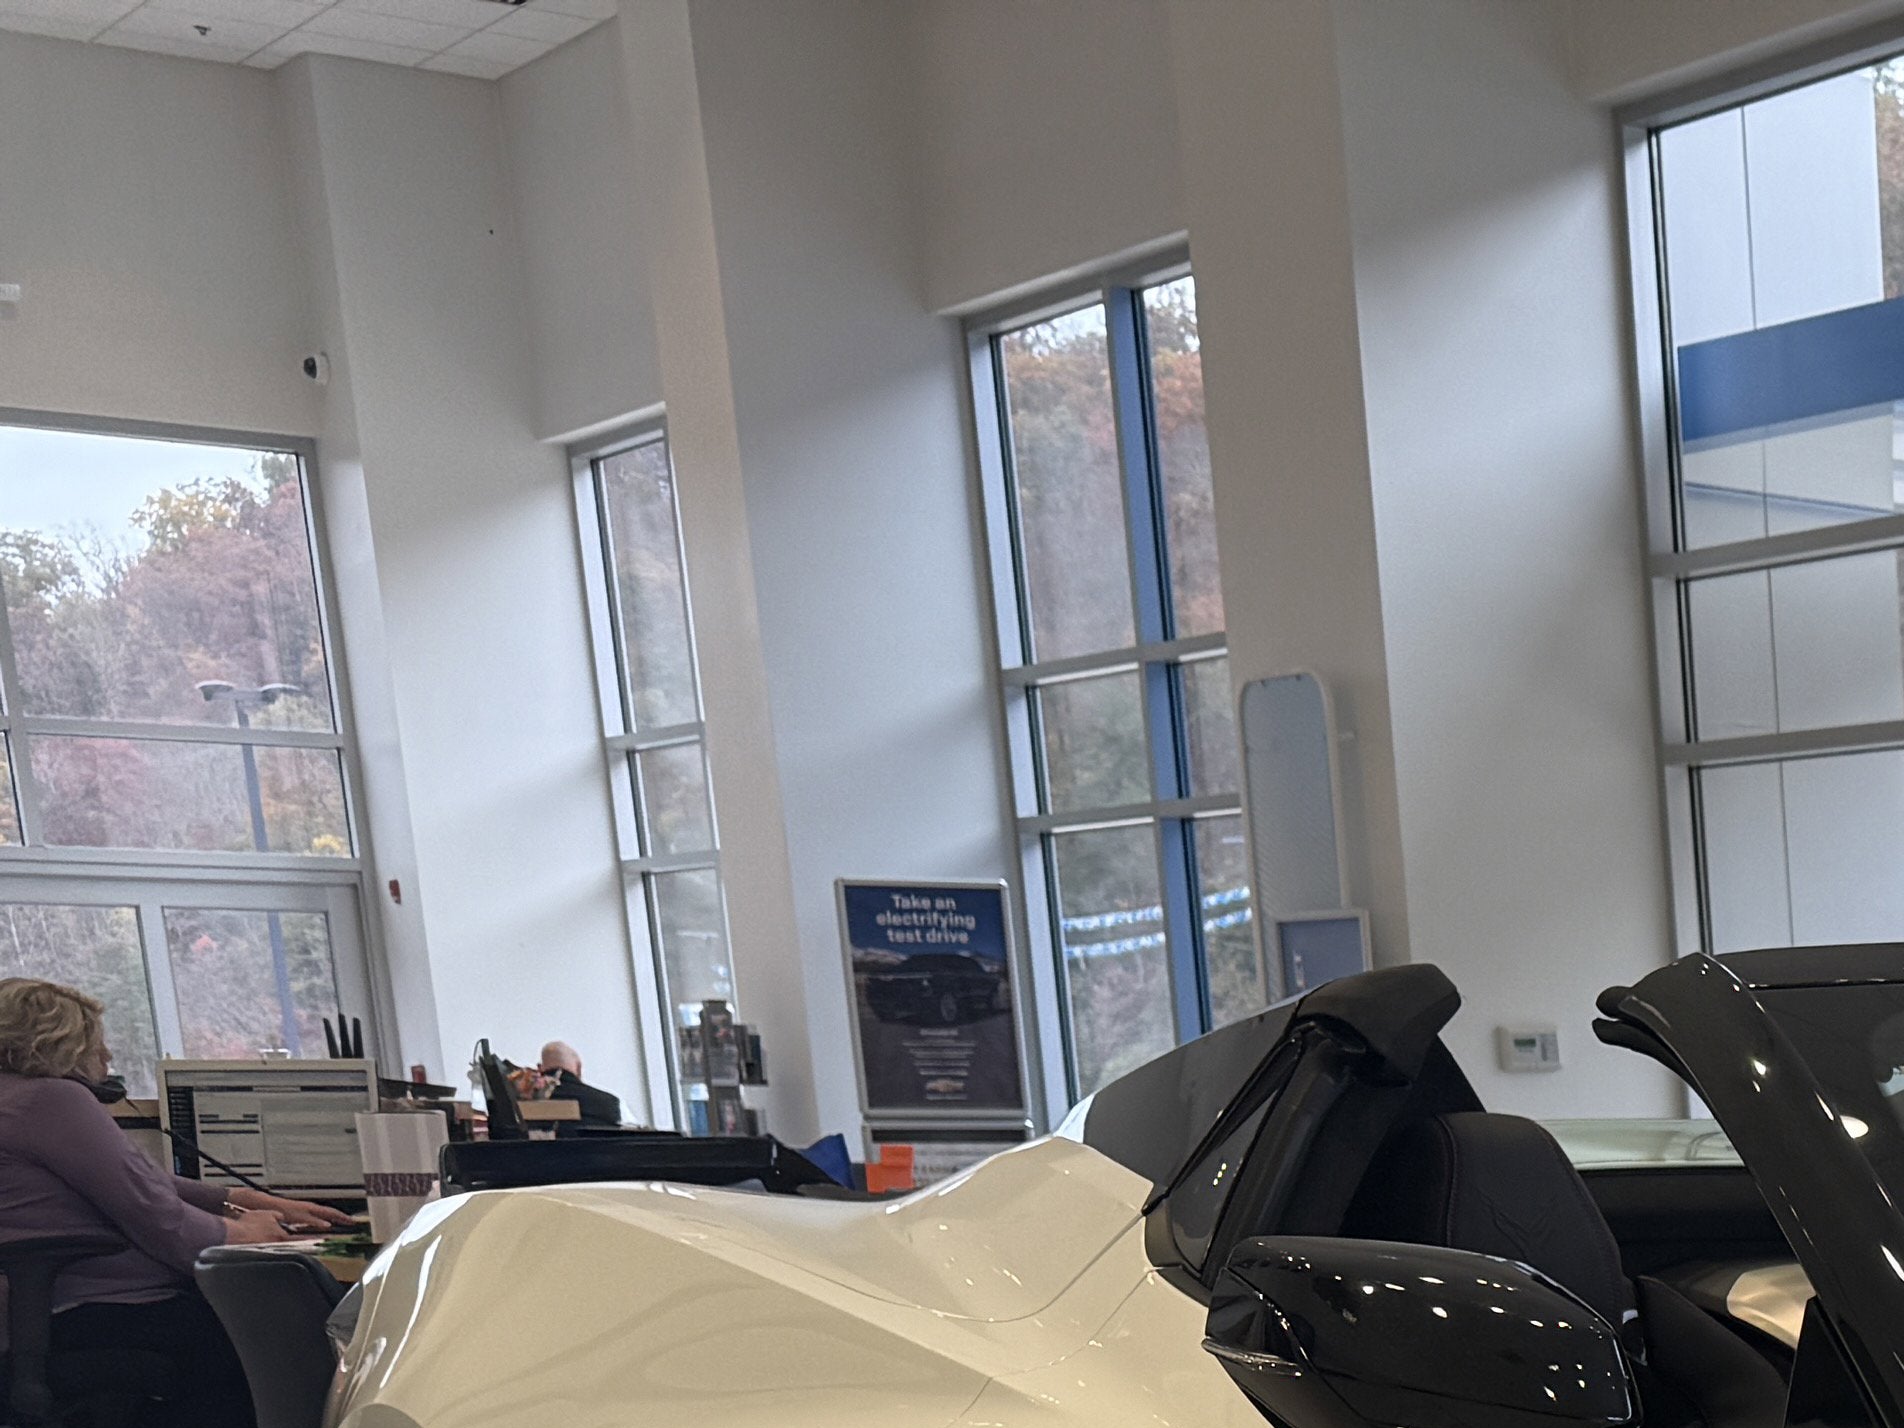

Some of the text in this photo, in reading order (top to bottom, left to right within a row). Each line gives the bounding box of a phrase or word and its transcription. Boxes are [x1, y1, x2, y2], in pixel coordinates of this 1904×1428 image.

[890, 894, 956, 910] Take an
[876, 910, 976, 930] electrifying
[887, 928, 969, 944] test drive
